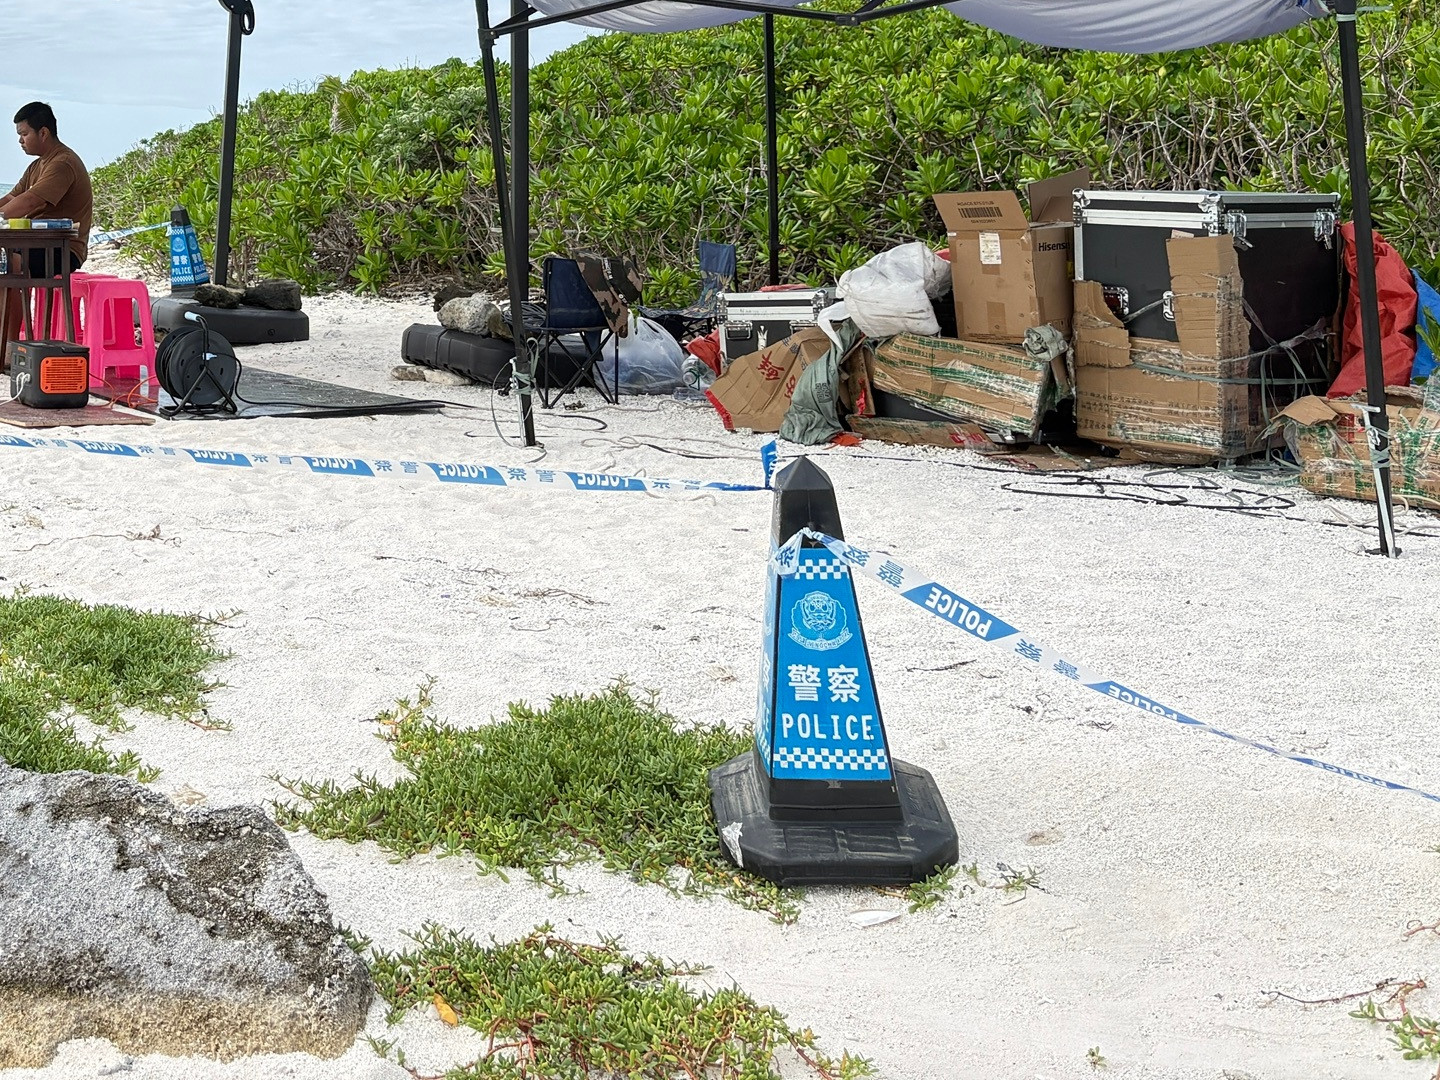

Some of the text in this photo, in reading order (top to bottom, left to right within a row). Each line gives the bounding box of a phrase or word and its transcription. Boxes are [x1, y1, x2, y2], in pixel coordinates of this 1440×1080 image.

[172, 267, 192, 275] POLICE
[925, 586, 992, 637] POLICE
[787, 664, 861, 703] 警察
[1108, 685, 1178, 721] POLICE
[782, 713, 875, 740] POLICE
[1312, 759, 1389, 787] POLICE
